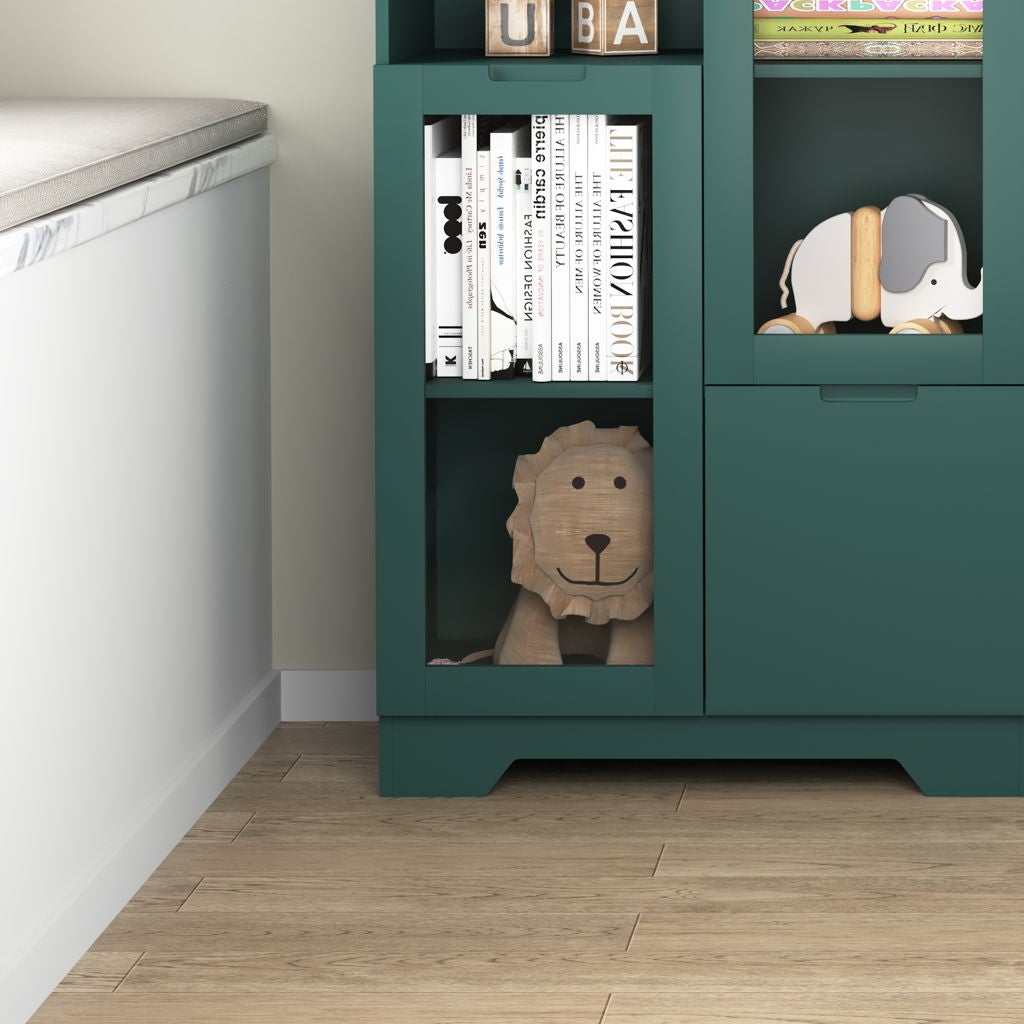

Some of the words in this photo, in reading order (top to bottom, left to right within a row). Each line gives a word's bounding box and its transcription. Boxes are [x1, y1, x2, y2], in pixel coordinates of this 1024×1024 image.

[500, 2, 536, 47] U
[577, 1, 595, 43] B
[613, 0, 649, 45] A
